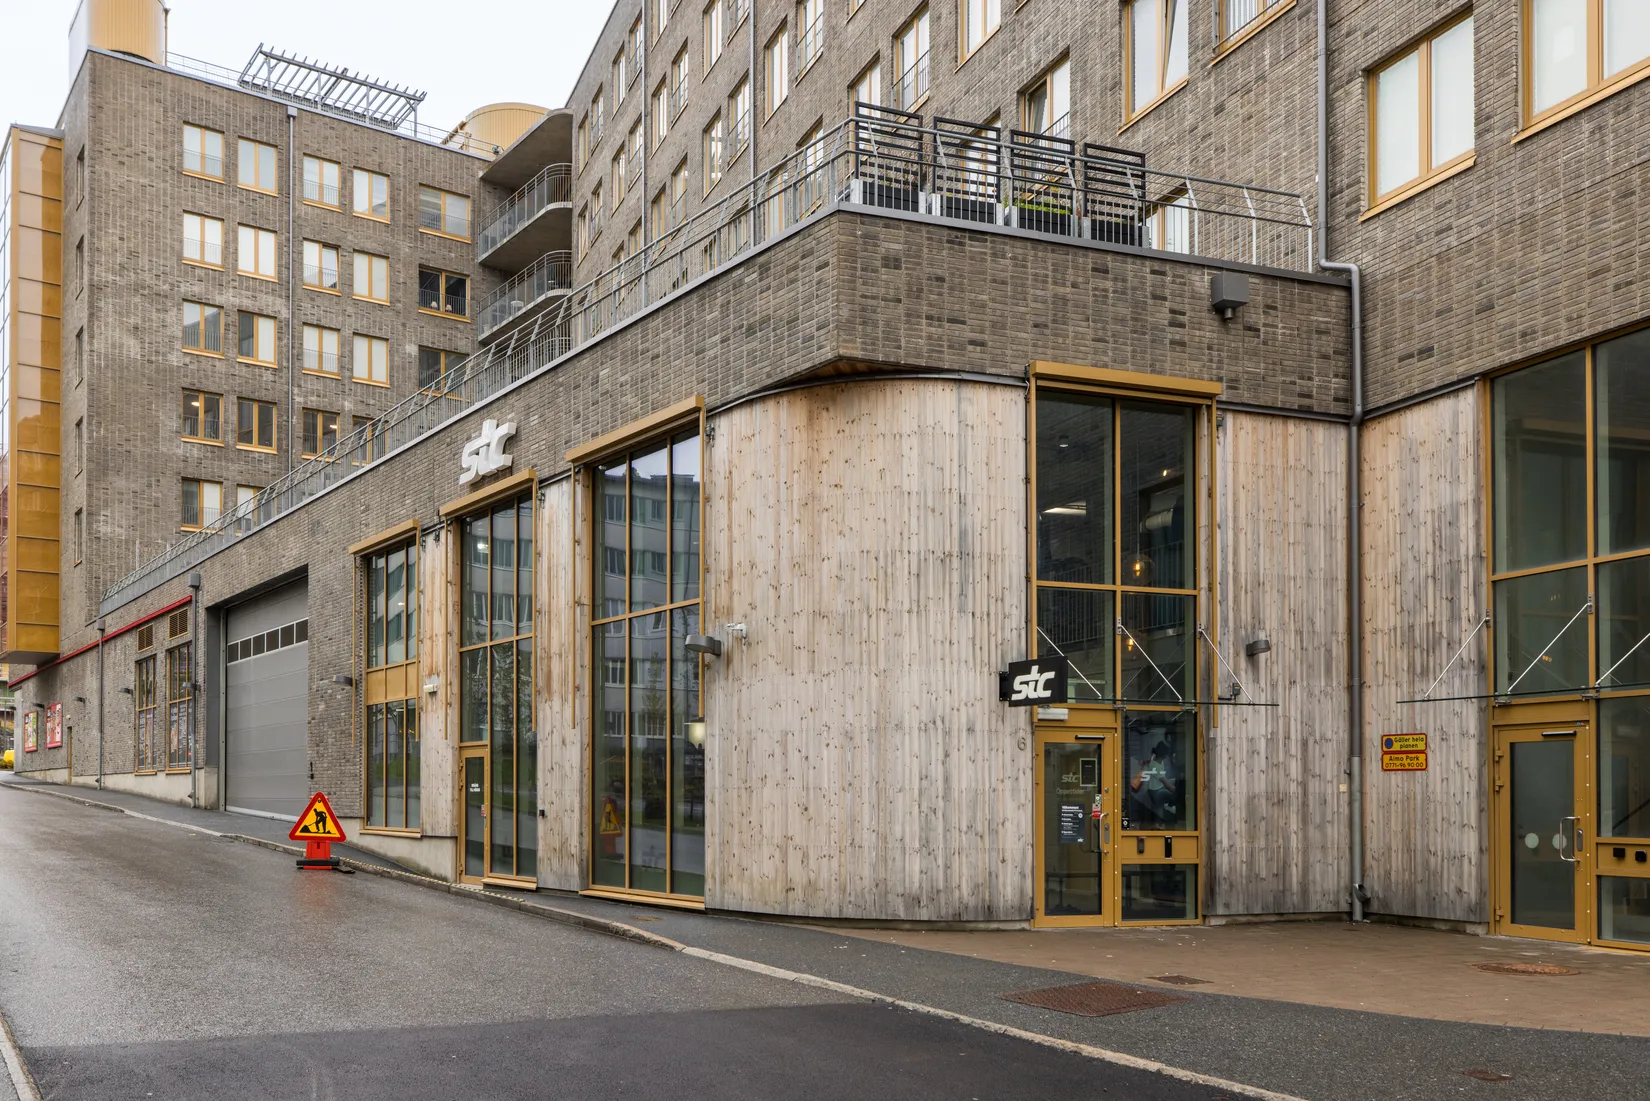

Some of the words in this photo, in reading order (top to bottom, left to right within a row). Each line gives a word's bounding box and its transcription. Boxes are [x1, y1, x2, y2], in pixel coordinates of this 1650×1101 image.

[459, 419, 517, 485] stc
[1011, 665, 1055, 700] stc
[1017, 737, 1027, 750] 6
[1061, 772, 1080, 783] stc
